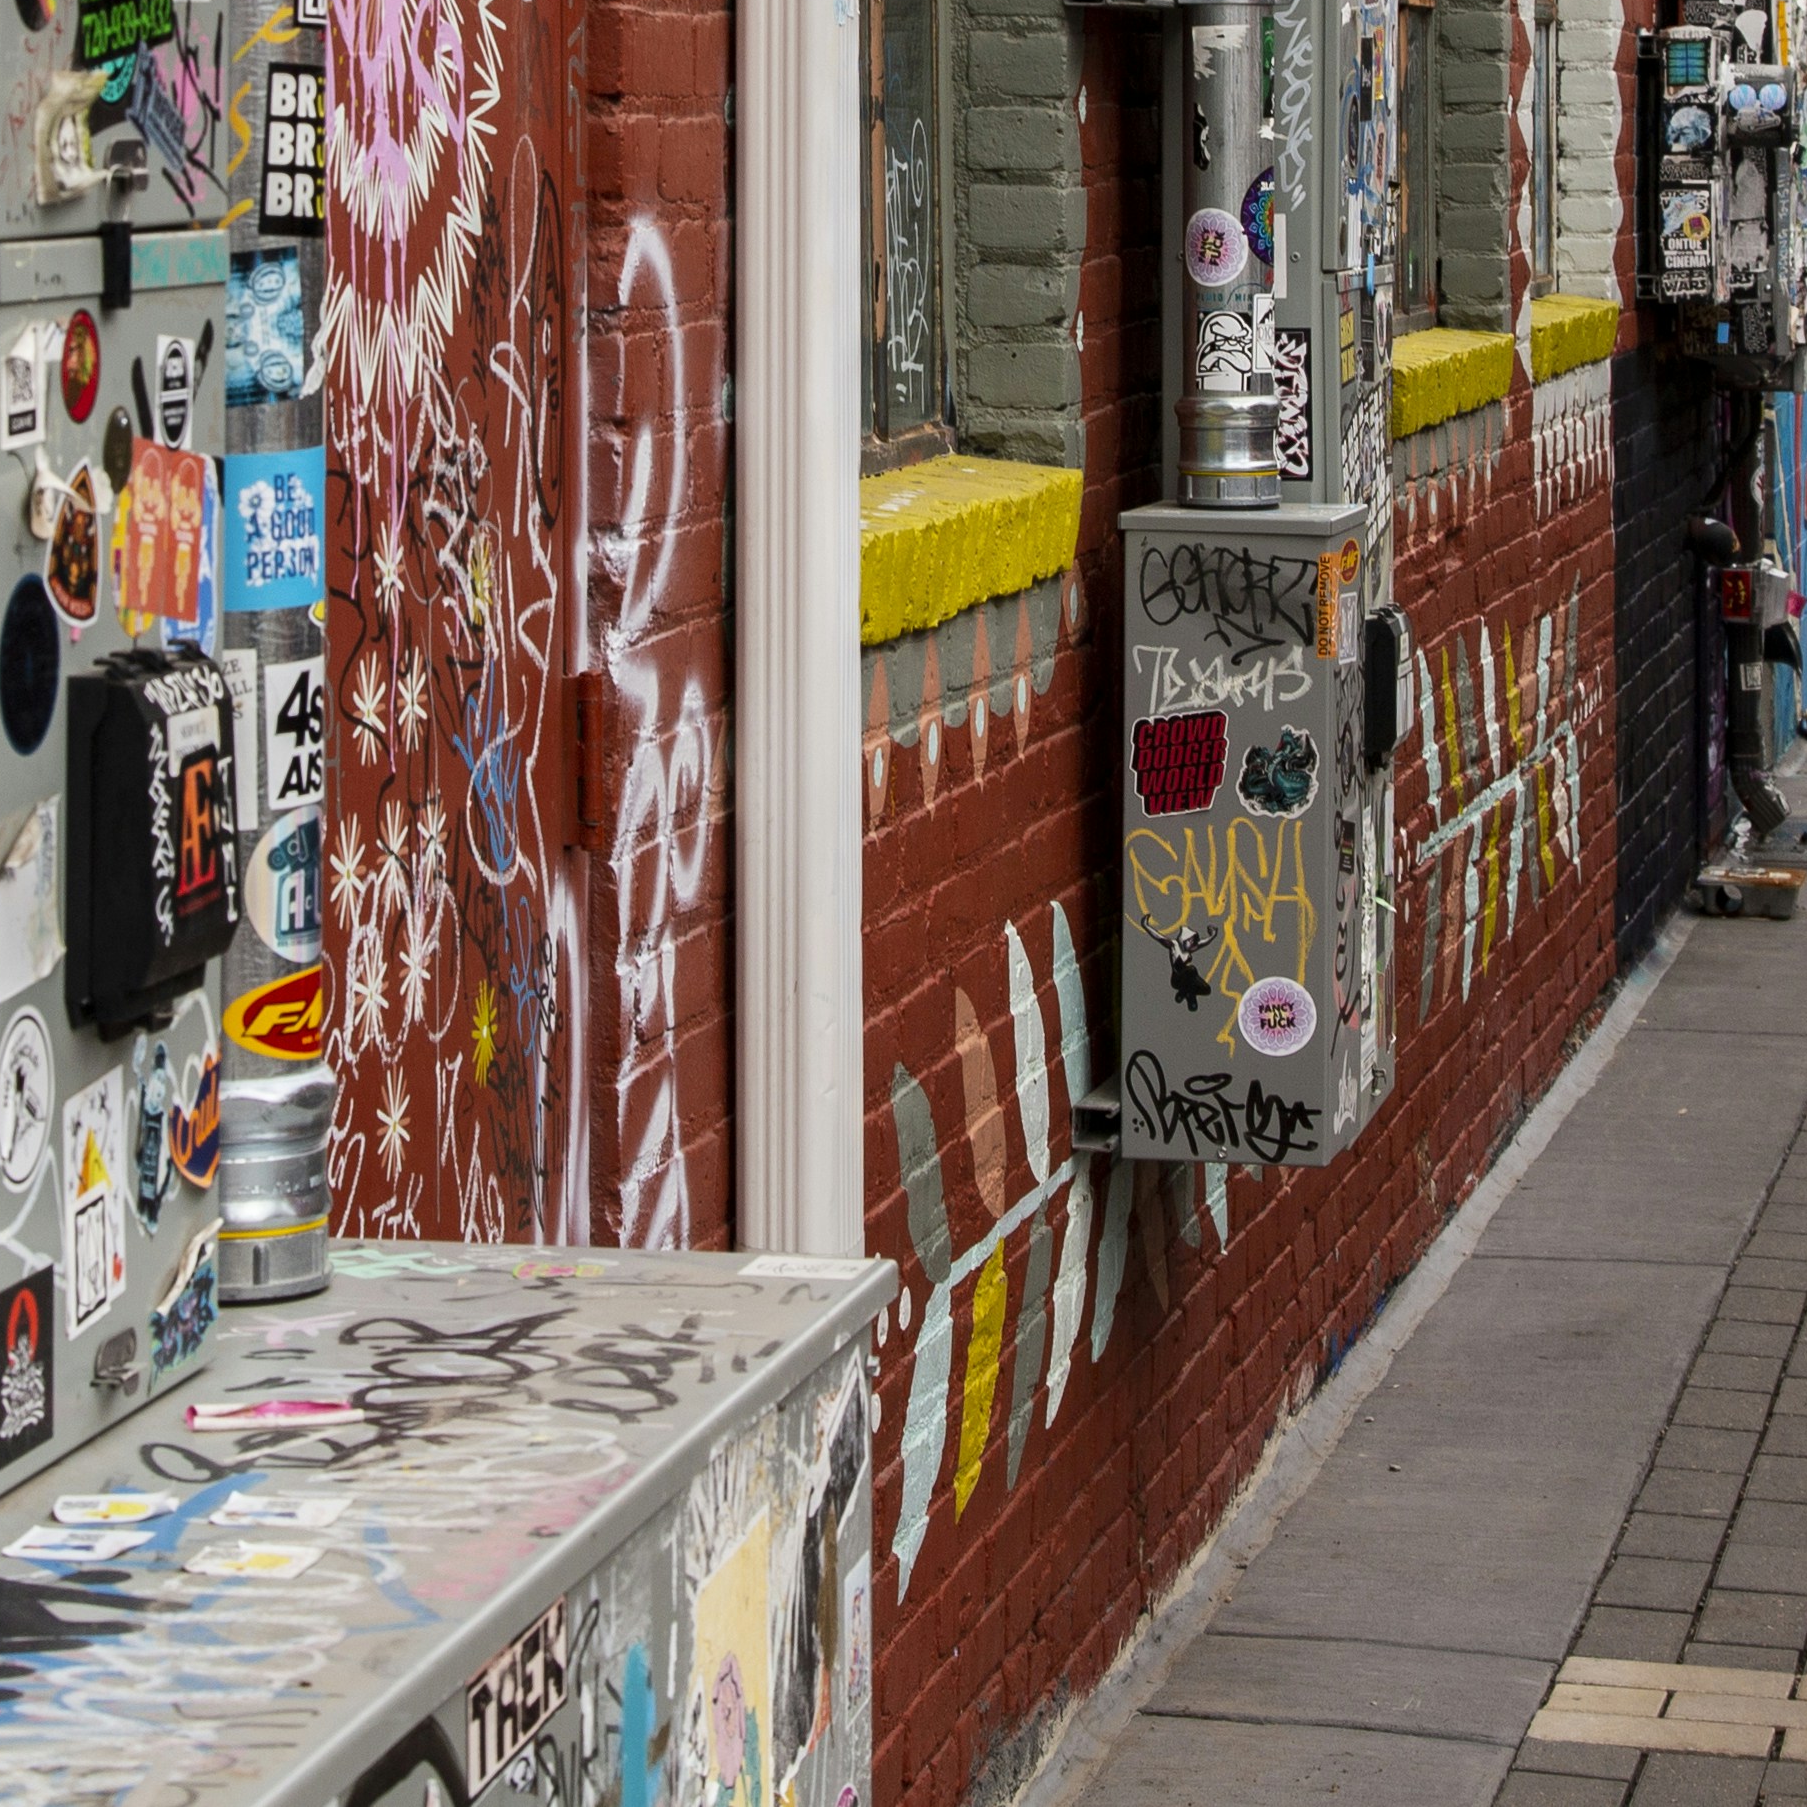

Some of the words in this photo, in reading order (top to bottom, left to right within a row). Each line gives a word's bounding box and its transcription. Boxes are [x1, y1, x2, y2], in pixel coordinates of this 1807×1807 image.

[1664, 253, 1708, 269] CINEMA
[270, 508, 316, 542] GOOD
[1318, 555, 1332, 607] REMOVE
[1318, 608, 1332, 635] NOT
[1137, 713, 1226, 741] CROWD
[1137, 739, 1227, 770] DODGER
[1141, 762, 1225, 793] WORLD
[1149, 789, 1214, 815] VIEW
[1258, 1001, 1295, 1015] FANCY
[1259, 1016, 1297, 1031] FUCK
